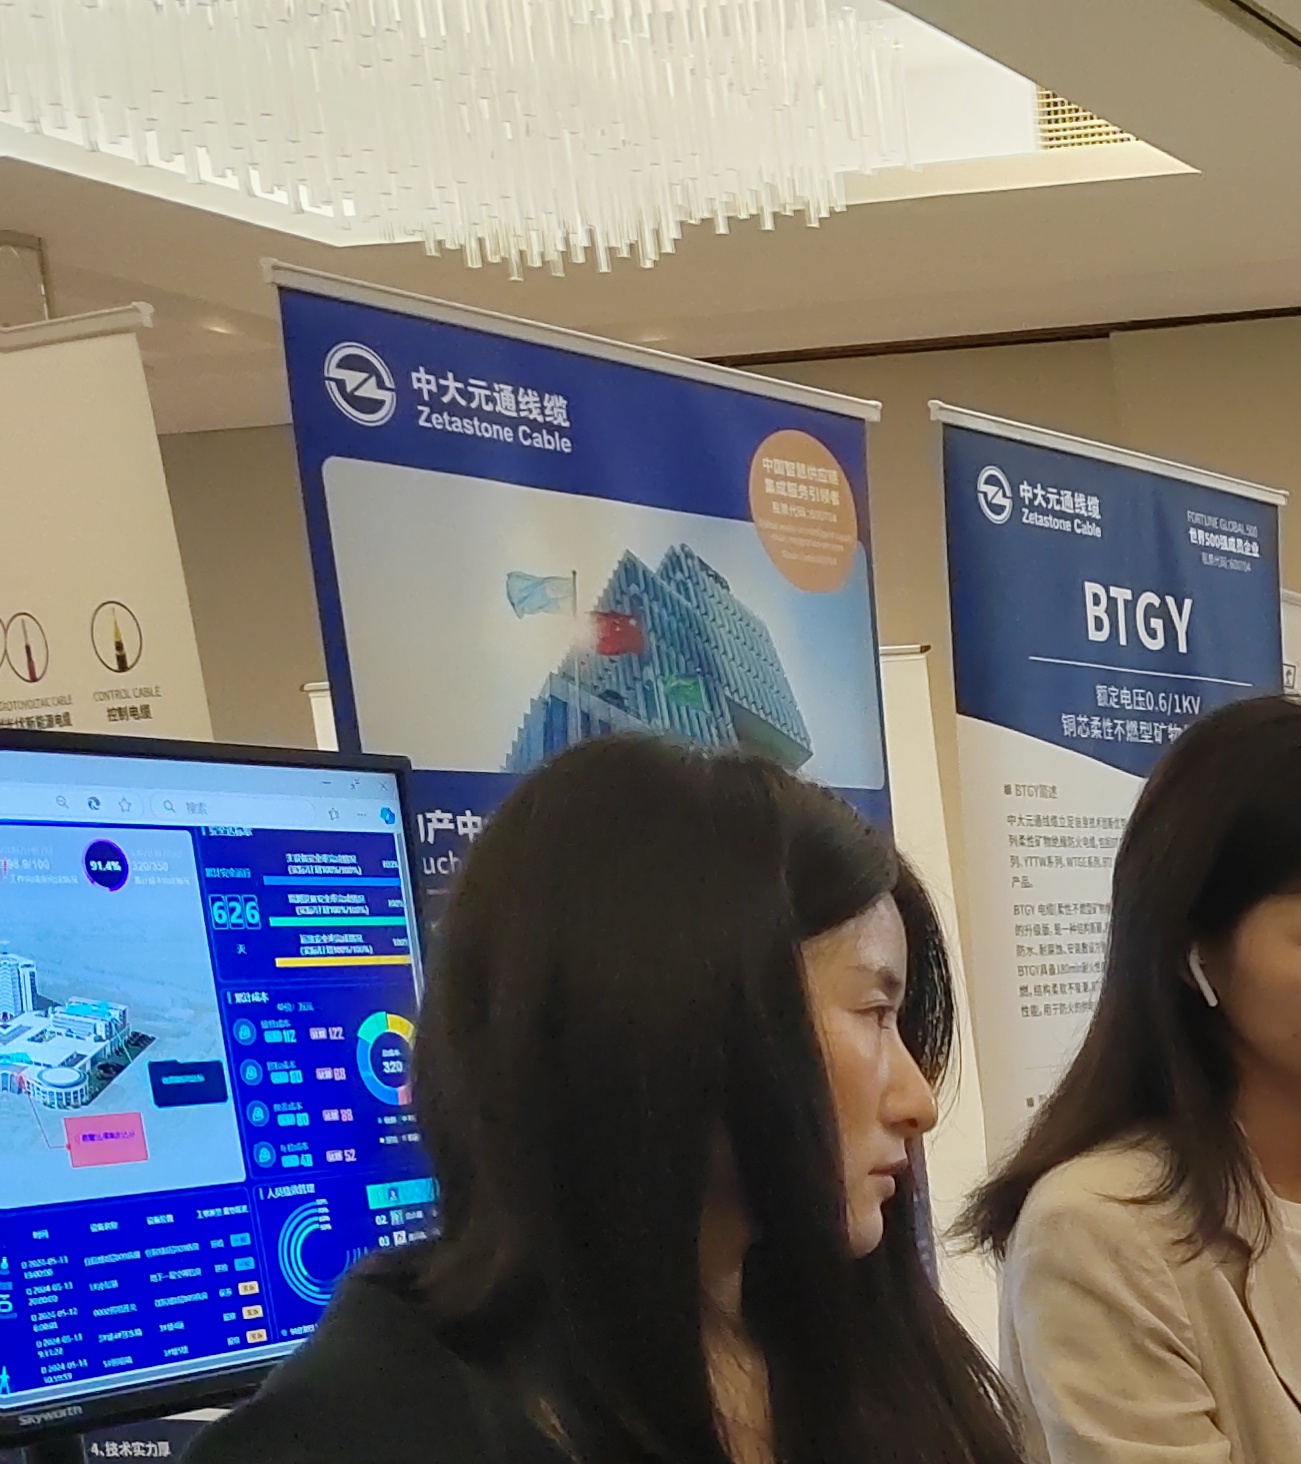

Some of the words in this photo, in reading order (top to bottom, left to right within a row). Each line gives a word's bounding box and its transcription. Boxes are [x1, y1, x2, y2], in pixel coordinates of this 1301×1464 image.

[411, 366, 570, 428] 中大元通线缆
[418, 406, 514, 443] Zetastone
[518, 424, 573, 454] Cable
[1019, 480, 1102, 521] 中大元通线缆
[1022, 507, 1073, 533] Zetastone
[1073, 513, 1102, 539] Cable
[1083, 580, 1193, 655] BTGY
[93, 689, 131, 702] CONTROL
[133, 686, 162, 699] CABLE
[1095, 684, 1200, 716] 额定电压0.6/1KV
[107, 704, 152, 723] 控制电缆
[1061, 713, 1185, 745] 铜芯柔性不燃型矿物
[1015, 784, 1058, 799] BTGY简述
[89, 860, 122, 872] 91.4%
[212, 901, 260, 925] 626
[283, 1029, 297, 1043] 112
[329, 1027, 344, 1040] 122
[382, 1061, 403, 1073] 320
[344, 1149, 357, 1163] 52
[375, 1215, 388, 1226] 02
[379, 1236, 390, 1247] 03
[19, 1404, 83, 1427] Skyworth
